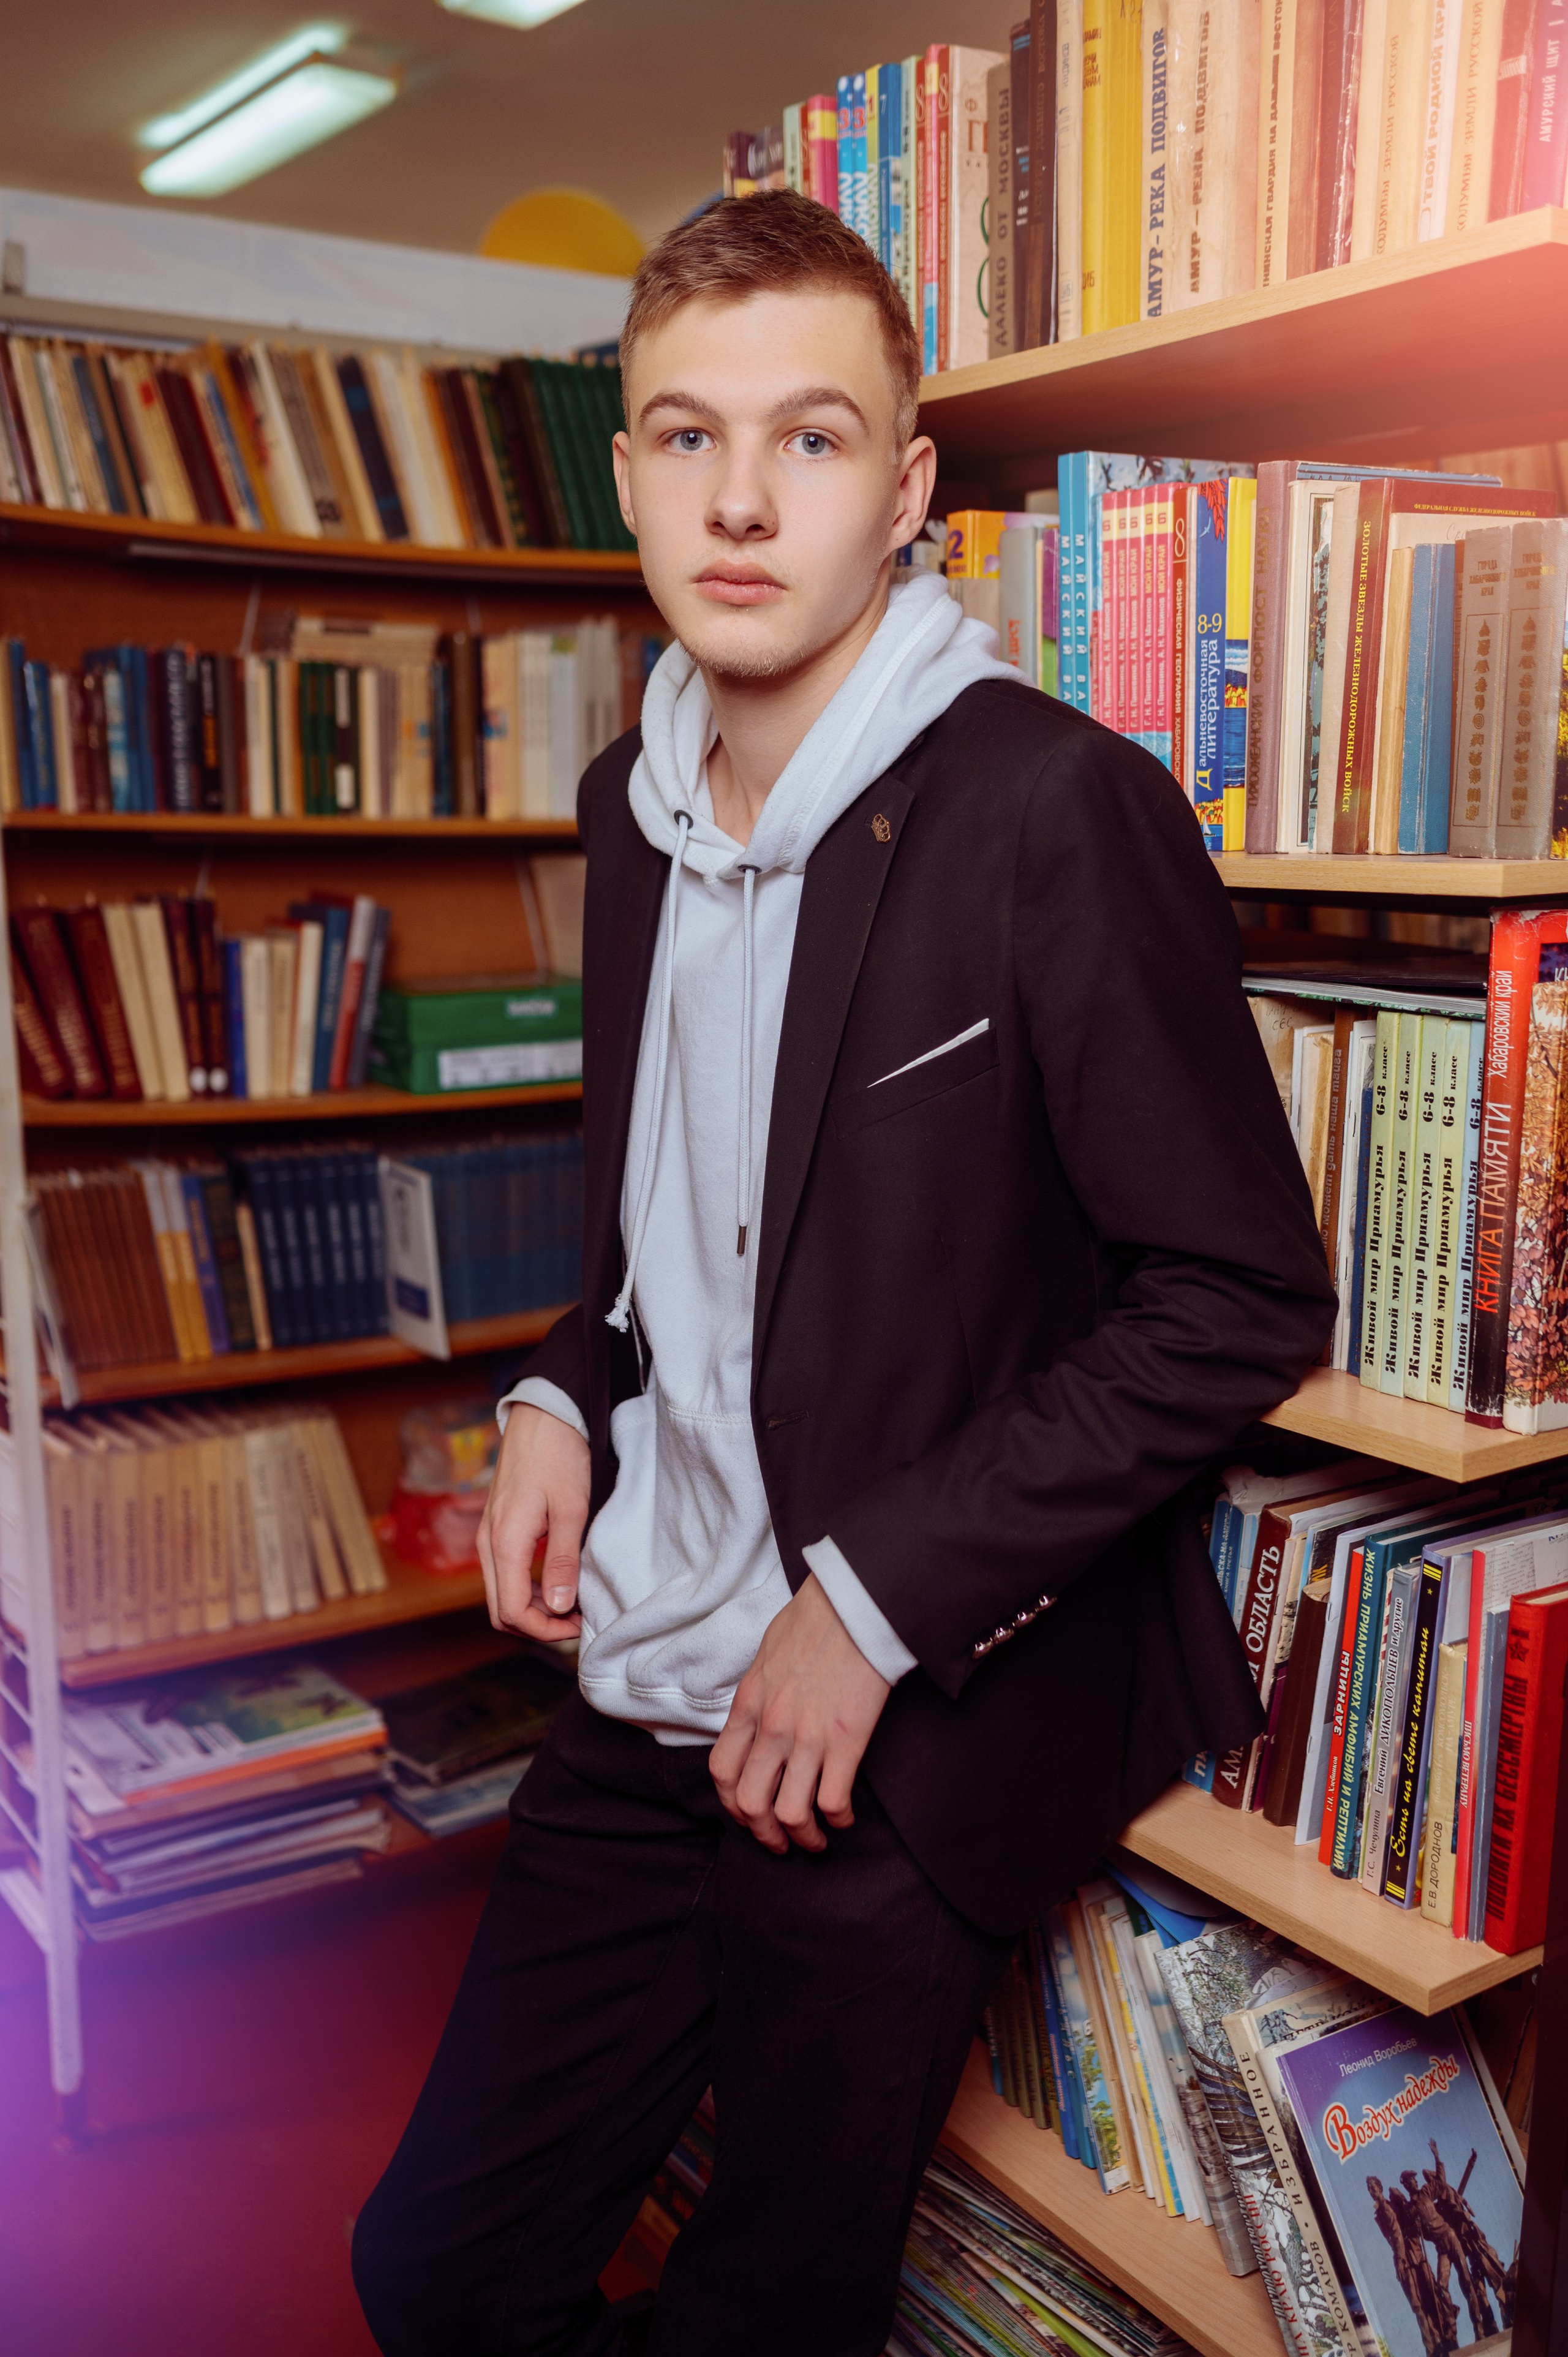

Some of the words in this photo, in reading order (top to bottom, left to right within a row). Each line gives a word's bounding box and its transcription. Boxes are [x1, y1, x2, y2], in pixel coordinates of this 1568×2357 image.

[1468, 1, 1483, 78] РУССКОЙ
[1546, 39, 1560, 69] ЩИТ
[938, 72, 949, 111] 8
[1382, 116, 1395, 172] ЗЕМЛИ
[1389, 34, 1400, 109] РУССКОЙ
[1428, 45, 1444, 140] РОДНОЙ
[1464, 86, 1477, 145] ЗЕМЛИ
[1539, 74, 1556, 143] АМУРСКИЙ
[998, 88, 1009, 194] МОСКВЫ
[1269, 124, 1277, 145] НА
[1149, 162, 1166, 231] РЕКА
[1192, 146, 1204, 206] РЕКА
[1266, 149, 1276, 211] ГВАРДИЯ
[1422, 144, 1438, 205] ТВОЙ
[997, 212, 1009, 239] ОТ
[1147, 247, 1163, 318] АМУР
[1190, 230, 1201, 293] АМУР
[994, 256, 1008, 347] ДАЛЕКО
[1414, 503, 1449, 512] ФЕДЕРАЛЬНАЯ
[1470, 507, 1520, 516] ЖЕЛЕЗНОДОРОЖНЫХ
[949, 530, 963, 559] 2
[1174, 518, 1185, 557] 8
[1257, 507, 1272, 575] НАУКИ
[1360, 521, 1371, 582] ЗОЛОТЫЕ
[1477, 559, 1498, 571] ГОРОДА
[1061, 535, 1072, 655] МАЙСКИЙ
[1076, 534, 1087, 655] МАЙСКИЙ
[1355, 583, 1367, 633] ЗВЕЗДЫ
[1145, 638, 1153, 648] Н.
[1158, 638, 1166, 648] Н.
[1197, 613, 1223, 635] 8-9
[1253, 586, 1267, 684] ФОРПОСТ
[1144, 649, 1152, 658] А.
[1157, 649, 1165, 658] А.
[1144, 707, 1152, 717] Н.
[1157, 707, 1165, 717] Н.
[1207, 638, 1221, 760] литература
[1345, 635, 1363, 769] ЖЕЛЕЗНОДОРОЖНЫХ
[1247, 695, 1264, 810] ТИХООКЕАНСКИЙ
[1341, 771, 1353, 813] ВОЙСК
[1490, 970, 1518, 998] край
[1487, 1000, 1515, 1079] Хабаровский
[1332, 1049, 1343, 1093] тайга
[1330, 1096, 1340, 1131] наша
[1376, 1085, 1387, 1116] 6-8
[1398, 1090, 1409, 1121] 6-8
[1422, 1091, 1435, 1123] 6-8
[1442, 1096, 1455, 1128] 6-8
[1470, 1098, 1481, 1129] 6-8
[1325, 1135, 1336, 1171] дать
[1480, 1101, 1512, 1224] ПАМЯТИ
[1322, 1175, 1333, 1226] может
[1370, 1144, 1384, 1253] Приамурья
[1392, 1150, 1407, 1259] Приамурья
[1415, 1152, 1432, 1263] Приамурья
[1436, 1157, 1454, 1269] Приамурья
[1370, 1258, 1382, 1295] мир
[1392, 1264, 1404, 1302] мир
[1415, 1269, 1428, 1306] мир
[1437, 1273, 1449, 1312] мир
[1474, 1228, 1505, 1314] КНИГА
[1364, 1300, 1378, 1367] Живой
[1385, 1307, 1399, 1375] Живой
[1408, 1311, 1423, 1379] Живой
[1430, 1318, 1445, 1386] Живой
[1452, 1322, 1468, 1391] Живой
[1461, 1278, 1472, 1317] мир
[1245, 1545, 1280, 1653] ОБЛАСТЬ
[1362, 1547, 1376, 1601] ЖИЗНЬ
[1391, 1636, 1400, 1648] и
[1392, 1596, 1404, 1636] другие
[1351, 1602, 1371, 1710] ПРИАМУРСКИХ
[1412, 1626, 1430, 1718] капитан
[1332, 1650, 1351, 1737] ЗАРНИЦЫ
[1379, 1648, 1399, 1746] ДИКОПОЛЬЦЕВ
[1341, 1710, 1360, 1784] АМФИБИЙ
[1403, 1721, 1419, 1773] свете
[1462, 1719, 1472, 1756] ПИСЬМО
[1494, 1672, 1528, 1804] БЕССМЕРТНЫ
[1328, 1755, 1338, 1793] Хлебников
[1341, 1786, 1352, 1797] И
[1373, 1749, 1389, 1795] Евгений
[1403, 1778, 1412, 1803] на
[1459, 1756, 1470, 1809] ВЕТЕРАНУ
[1333, 1799, 1351, 1871] РЕПТИЛИЙ
[1369, 1809, 1381, 1855] Чечулина
[1390, 1808, 1409, 1858] Есть
[1493, 1806, 1515, 1833] ИХ
[1366, 1860, 1376, 1879] Г.С.
[1429, 1820, 1443, 1885] ДОРОДНОВ
[1486, 1833, 1512, 1921] ПОДВИГИ
[1428, 1887, 1438, 1909] Е.В.
[1339, 2053, 1376, 2078] Леонид
[1374, 2036, 1419, 2065] Воробьев
[1238, 2051, 1303, 2206] ИЗБРАННОЕ
[1324, 2103, 1402, 2161] Воздух
[1396, 2057, 1459, 2114] надежды
[1243, 2193, 1276, 2263] РОССИИ
[1270, 2269, 1298, 2323] КРАЮ
[1309, 2241, 1351, 2333] КОМАРОВ
